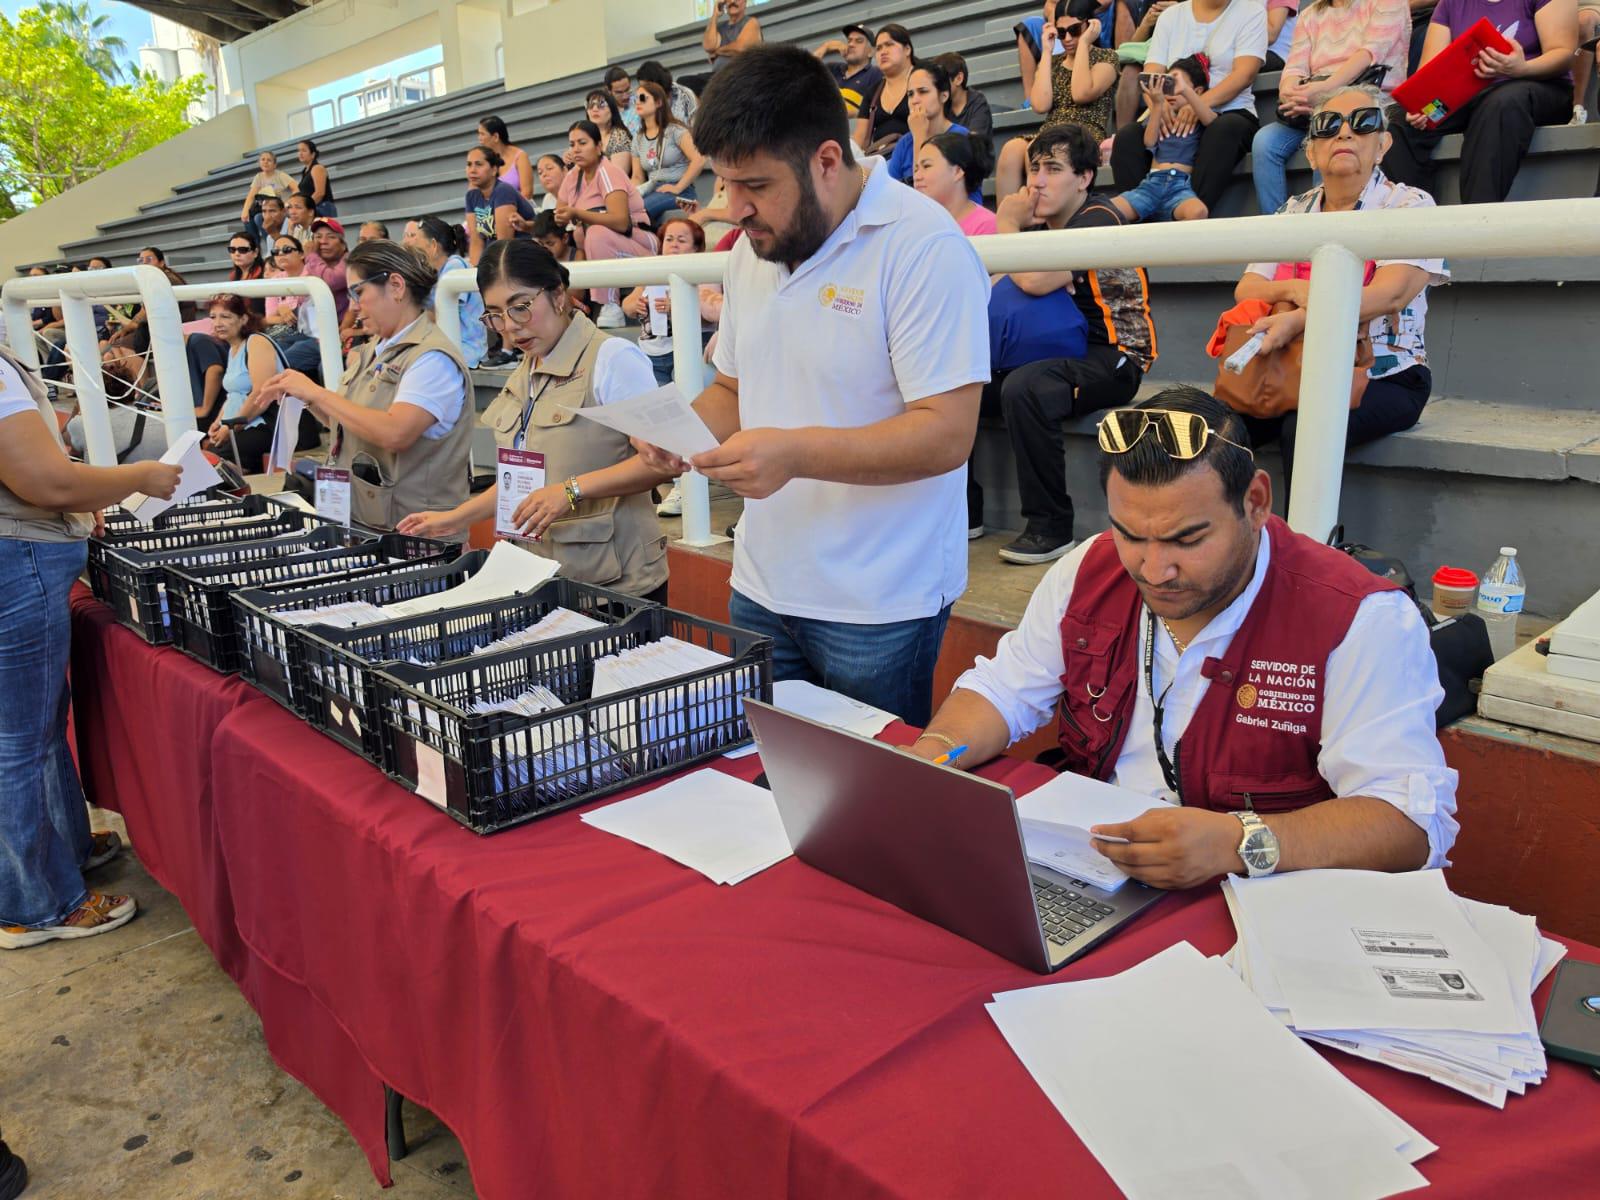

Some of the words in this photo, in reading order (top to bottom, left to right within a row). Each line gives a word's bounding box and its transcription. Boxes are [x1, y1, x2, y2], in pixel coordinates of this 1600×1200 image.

[1251, 660, 1298, 674] SERVIDOR
[1301, 665, 1316, 675] DE
[1248, 673, 1261, 683] LA
[1266, 675, 1316, 689] NACIÓN
[1258, 689, 1300, 700] GOBIERNO
[1302, 694, 1315, 702] DE
[1257, 697, 1315, 713] MÉXICO
[1236, 714, 1268, 728] Gabriel
[1271, 720, 1307, 734] Zuñiga
